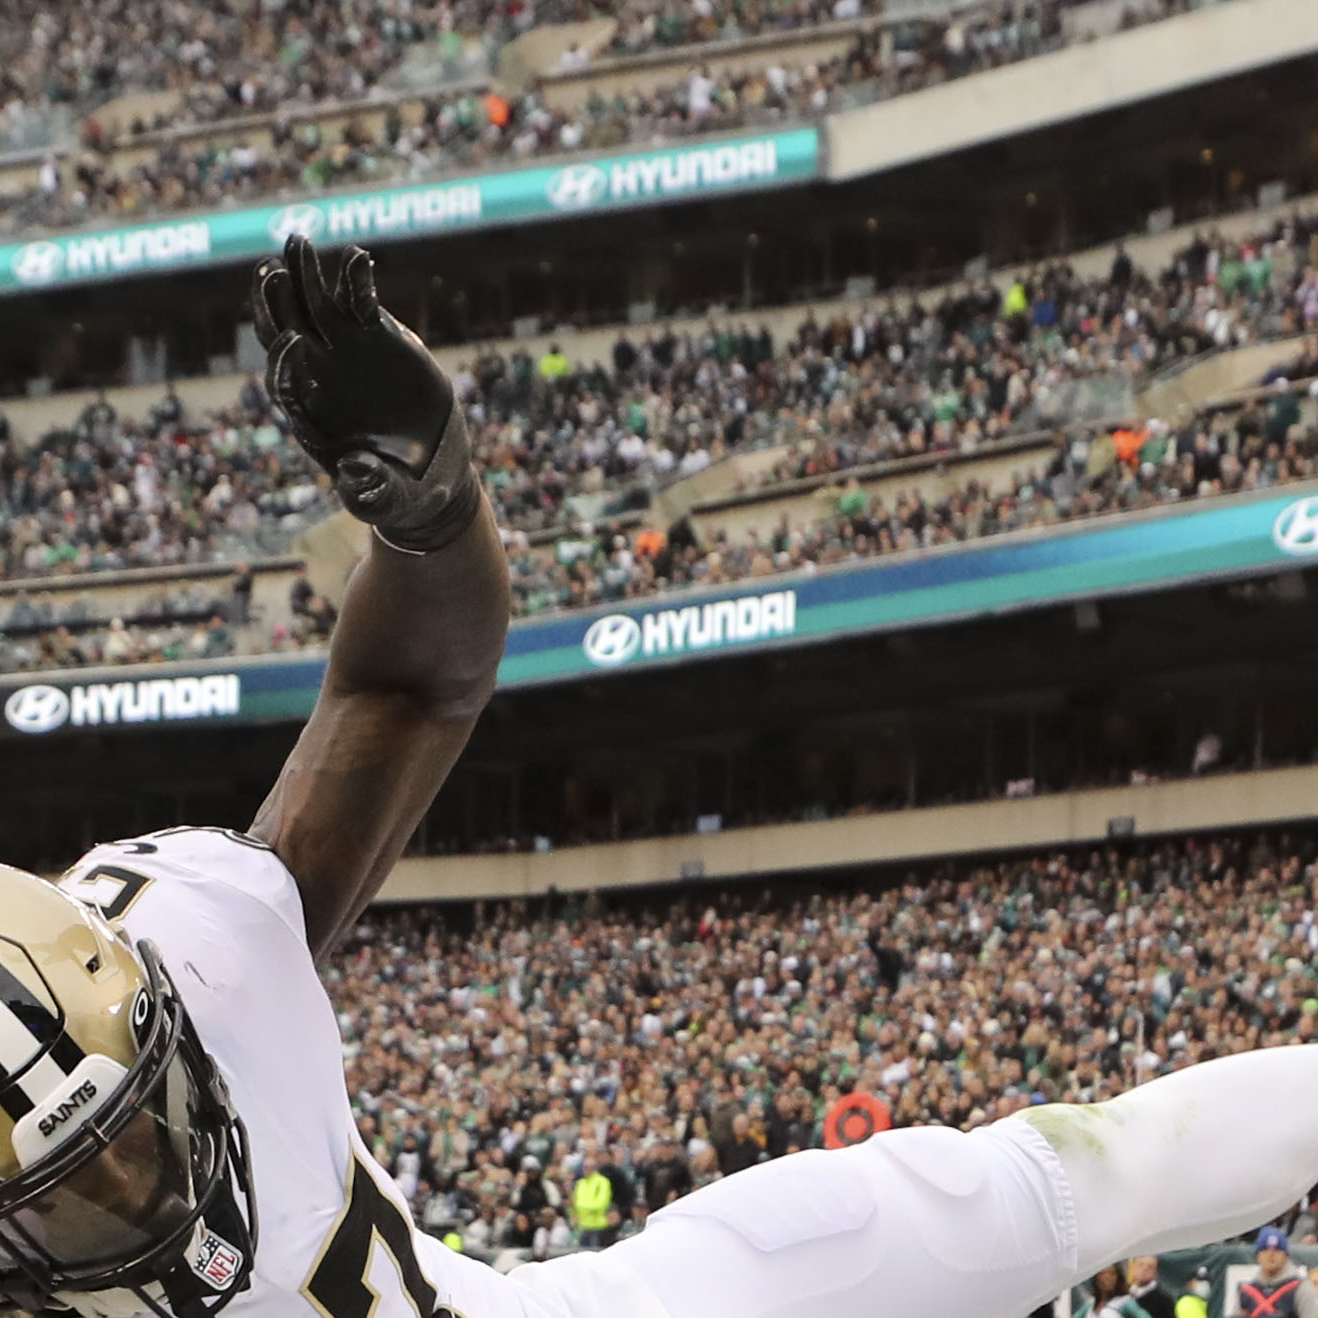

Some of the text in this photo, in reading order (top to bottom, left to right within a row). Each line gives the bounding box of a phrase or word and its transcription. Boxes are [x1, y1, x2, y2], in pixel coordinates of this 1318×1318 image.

[608, 140, 778, 199] HYUNDAI
[326, 184, 482, 235] HYUNDAI
[66, 221, 211, 270] HYUNDAI
[642, 589, 797, 655] HYUNDAI
[70, 673, 241, 726] HYUNDAI
[37, 1079, 98, 1137] SAINTS
[207, 1251, 237, 1283] NFL
